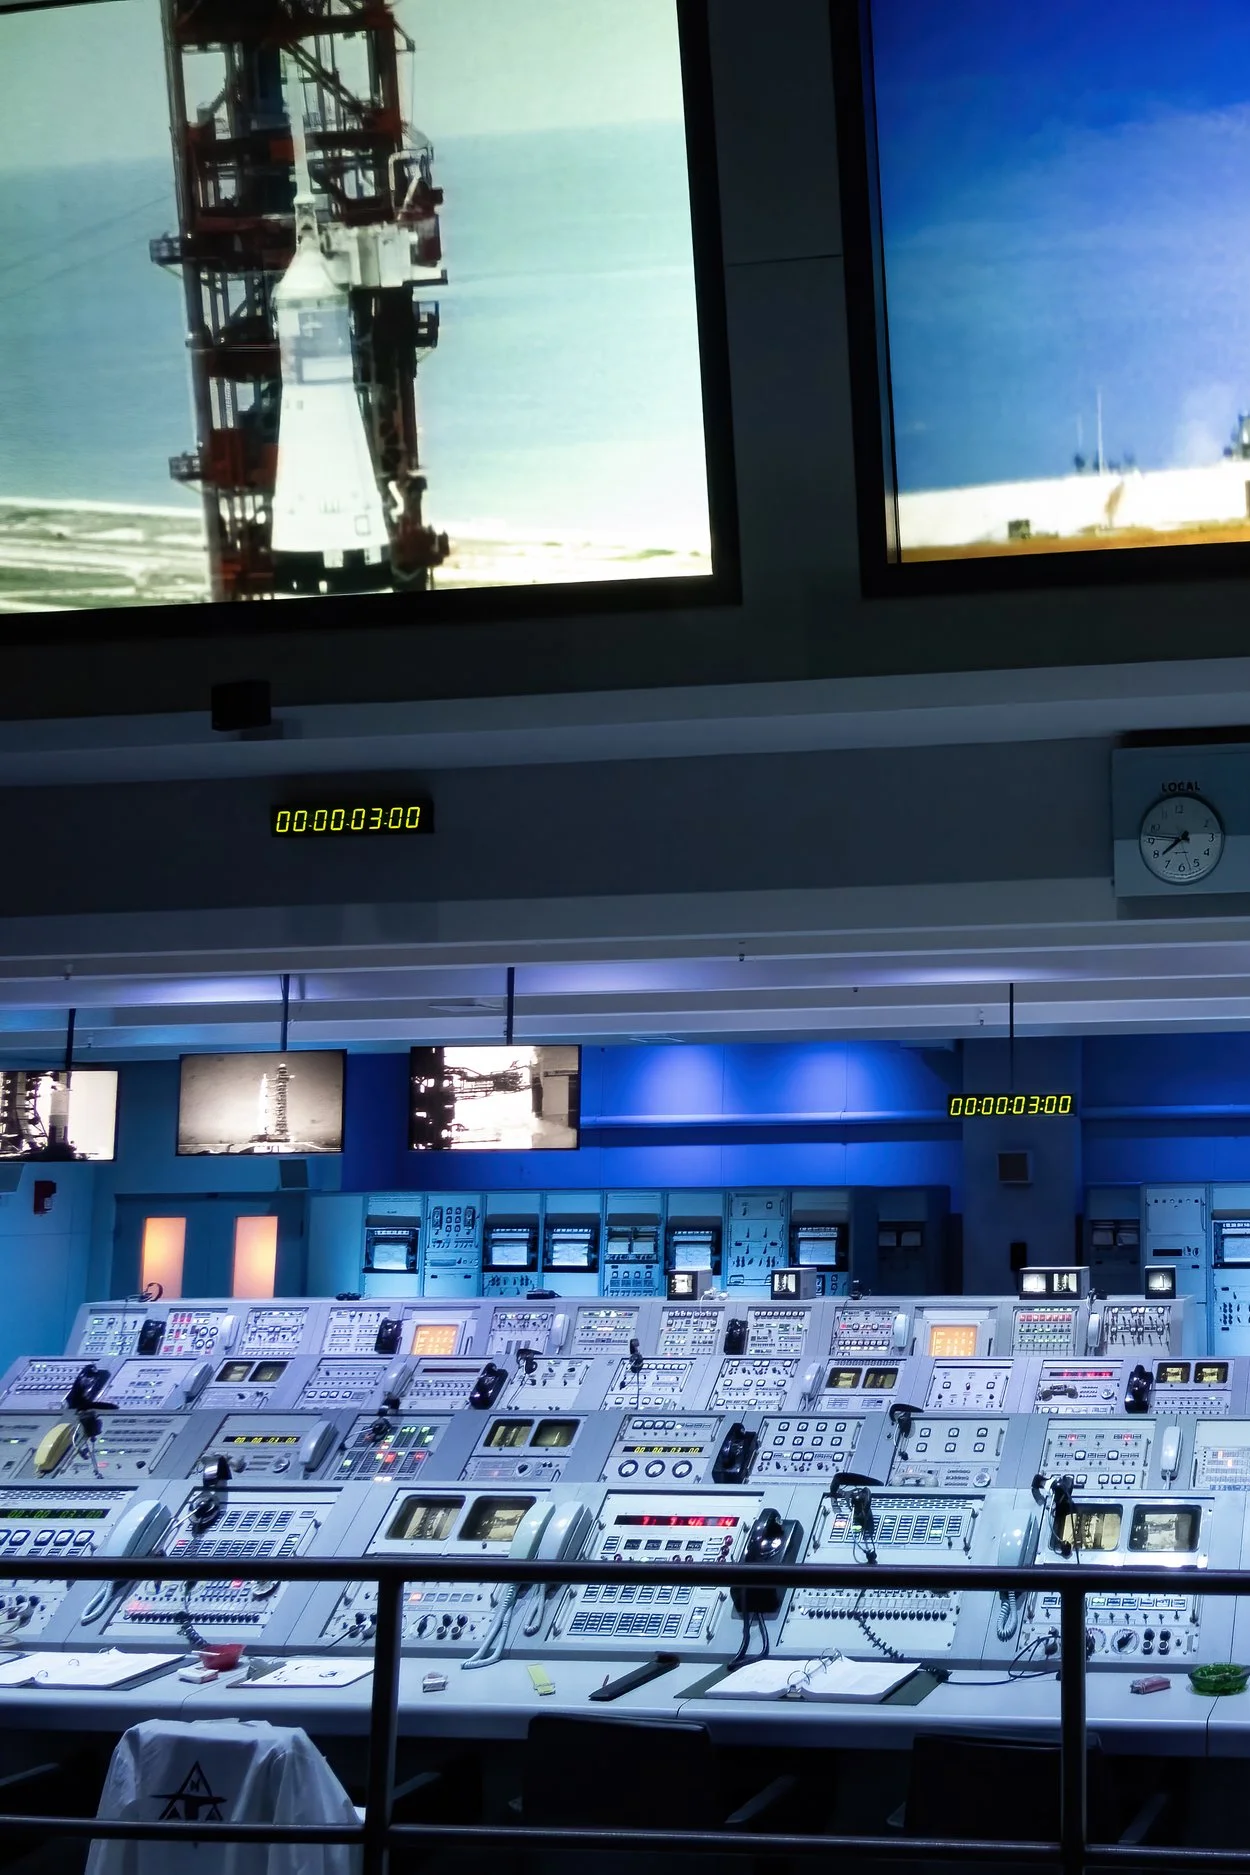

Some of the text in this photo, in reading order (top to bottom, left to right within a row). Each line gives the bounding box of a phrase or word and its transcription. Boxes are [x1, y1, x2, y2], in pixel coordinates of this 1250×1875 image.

[1161, 781, 1201, 792] LOCAL
[275, 806, 421, 833] 00:00:03:00
[949, 1095, 1072, 1116] 00:00:03:00
